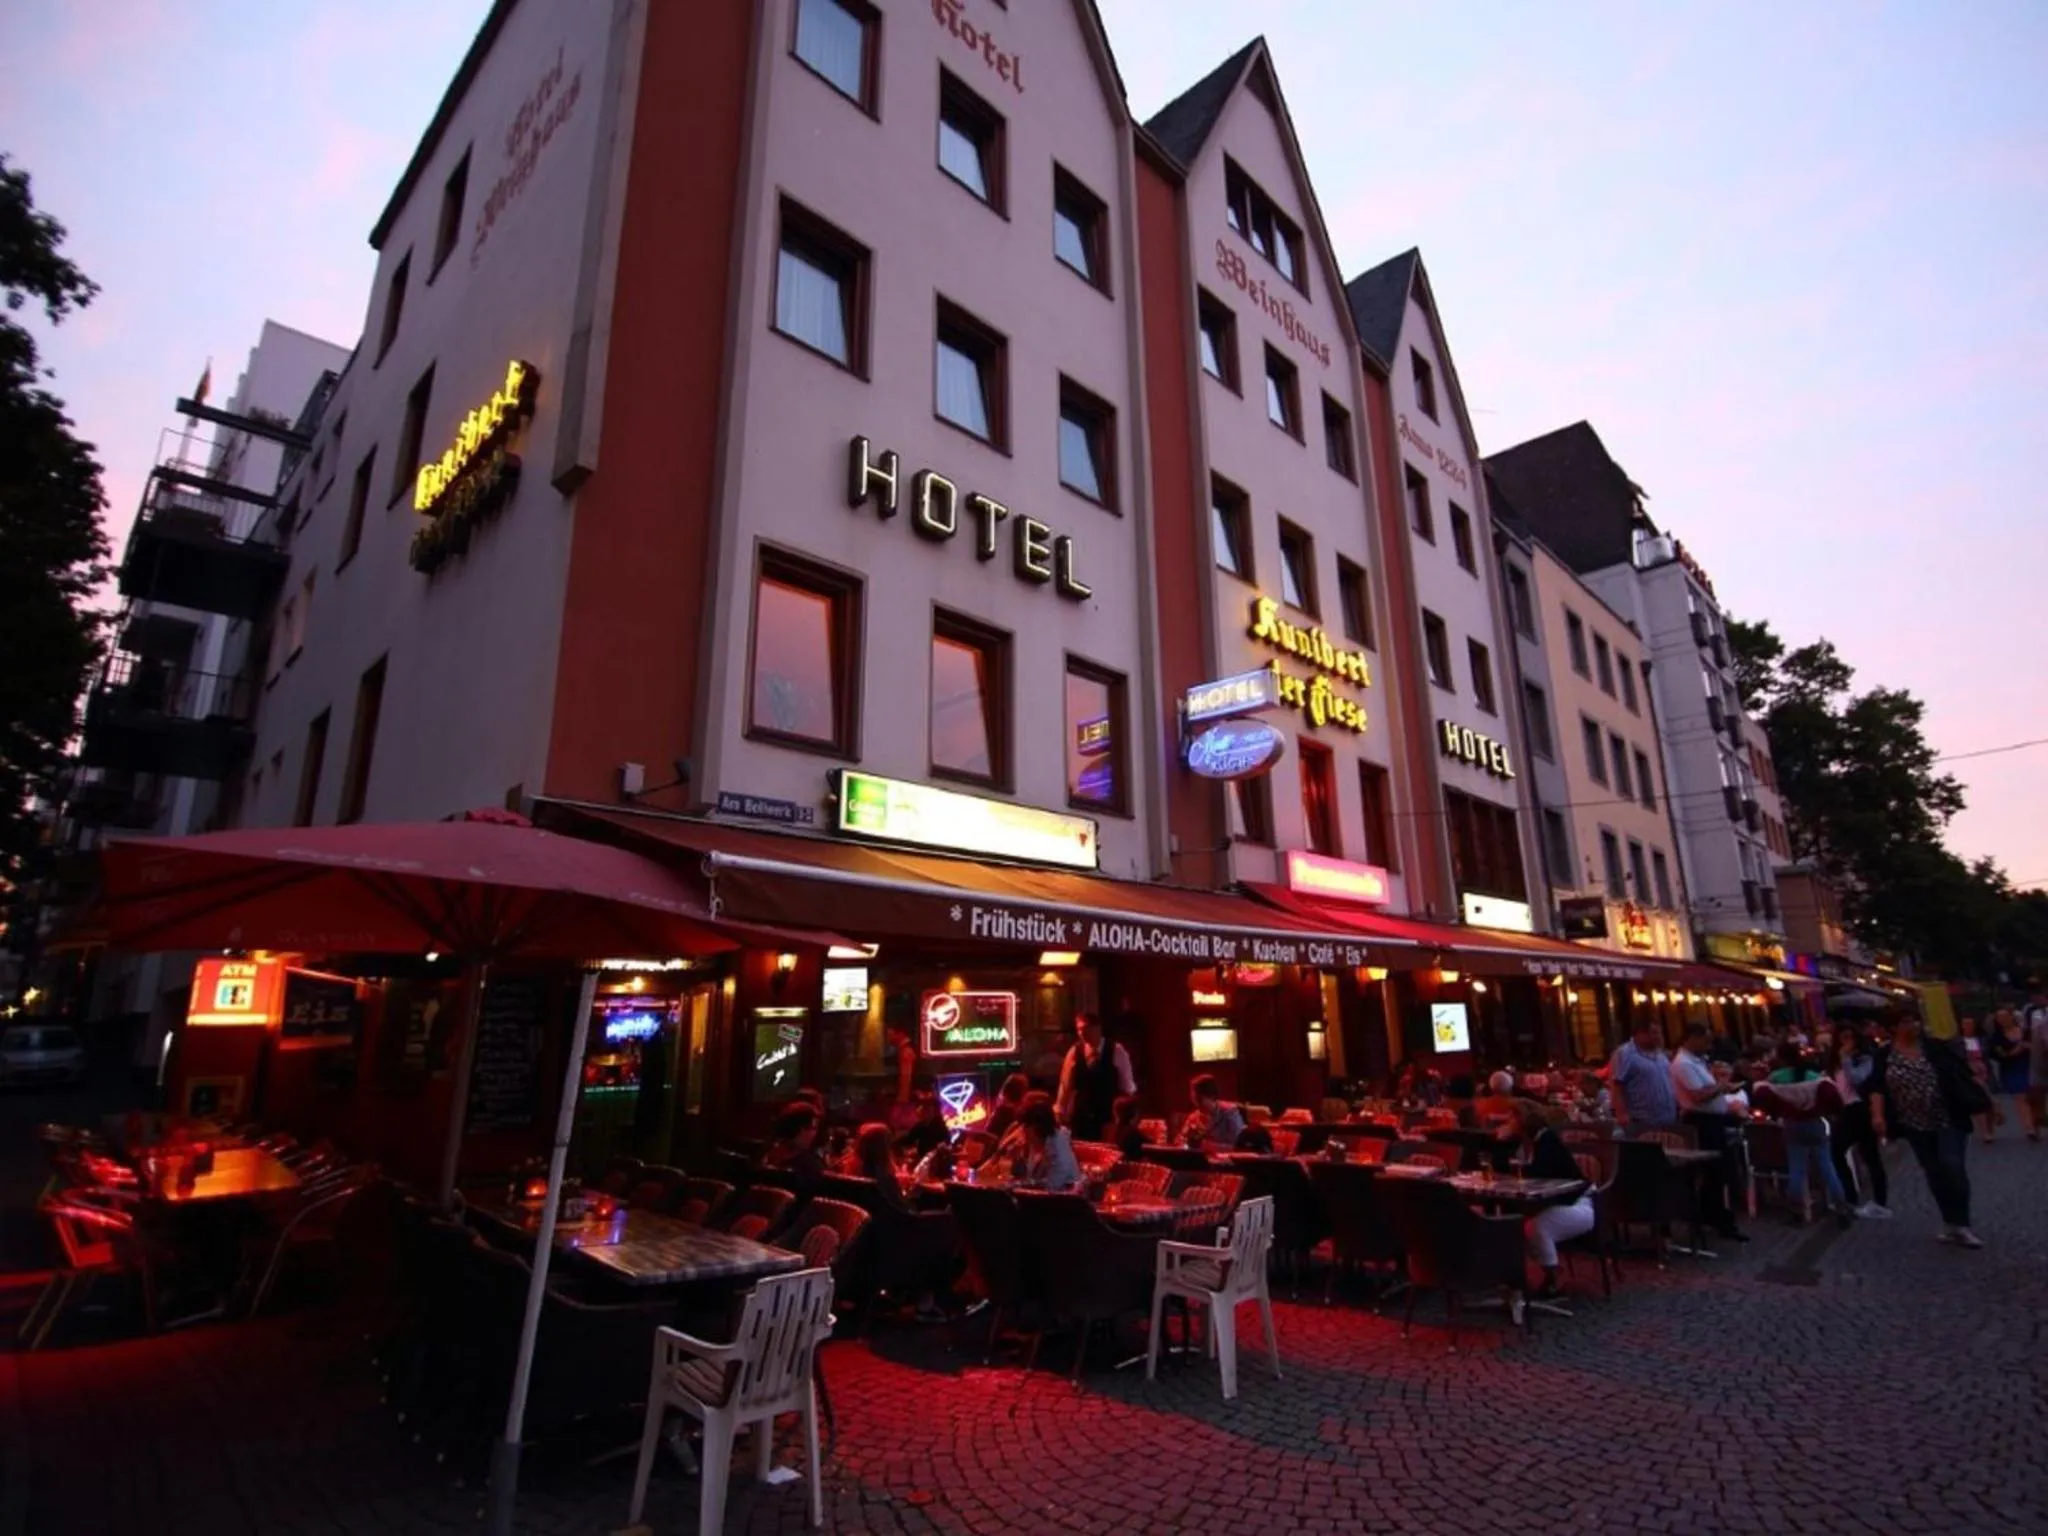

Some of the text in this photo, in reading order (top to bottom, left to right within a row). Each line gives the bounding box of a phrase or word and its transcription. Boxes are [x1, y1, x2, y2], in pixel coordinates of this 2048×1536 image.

[1215, 239, 1330, 368] Weinhaus
[849, 434, 1092, 600] HOTEL
[1251, 595, 1372, 688] Kunibert
[1187, 680, 1264, 714] HOTEL
[1437, 719, 1516, 779] HOTEL
[970, 905, 1067, 944] Frühstück
[1088, 922, 1209, 957] ALOHA-Cocktail
[1213, 935, 1236, 958] Bar
[1253, 938, 1296, 962] Kuchen
[220, 963, 258, 978] ATM
[945, 1028, 1009, 1042] ALOHA
